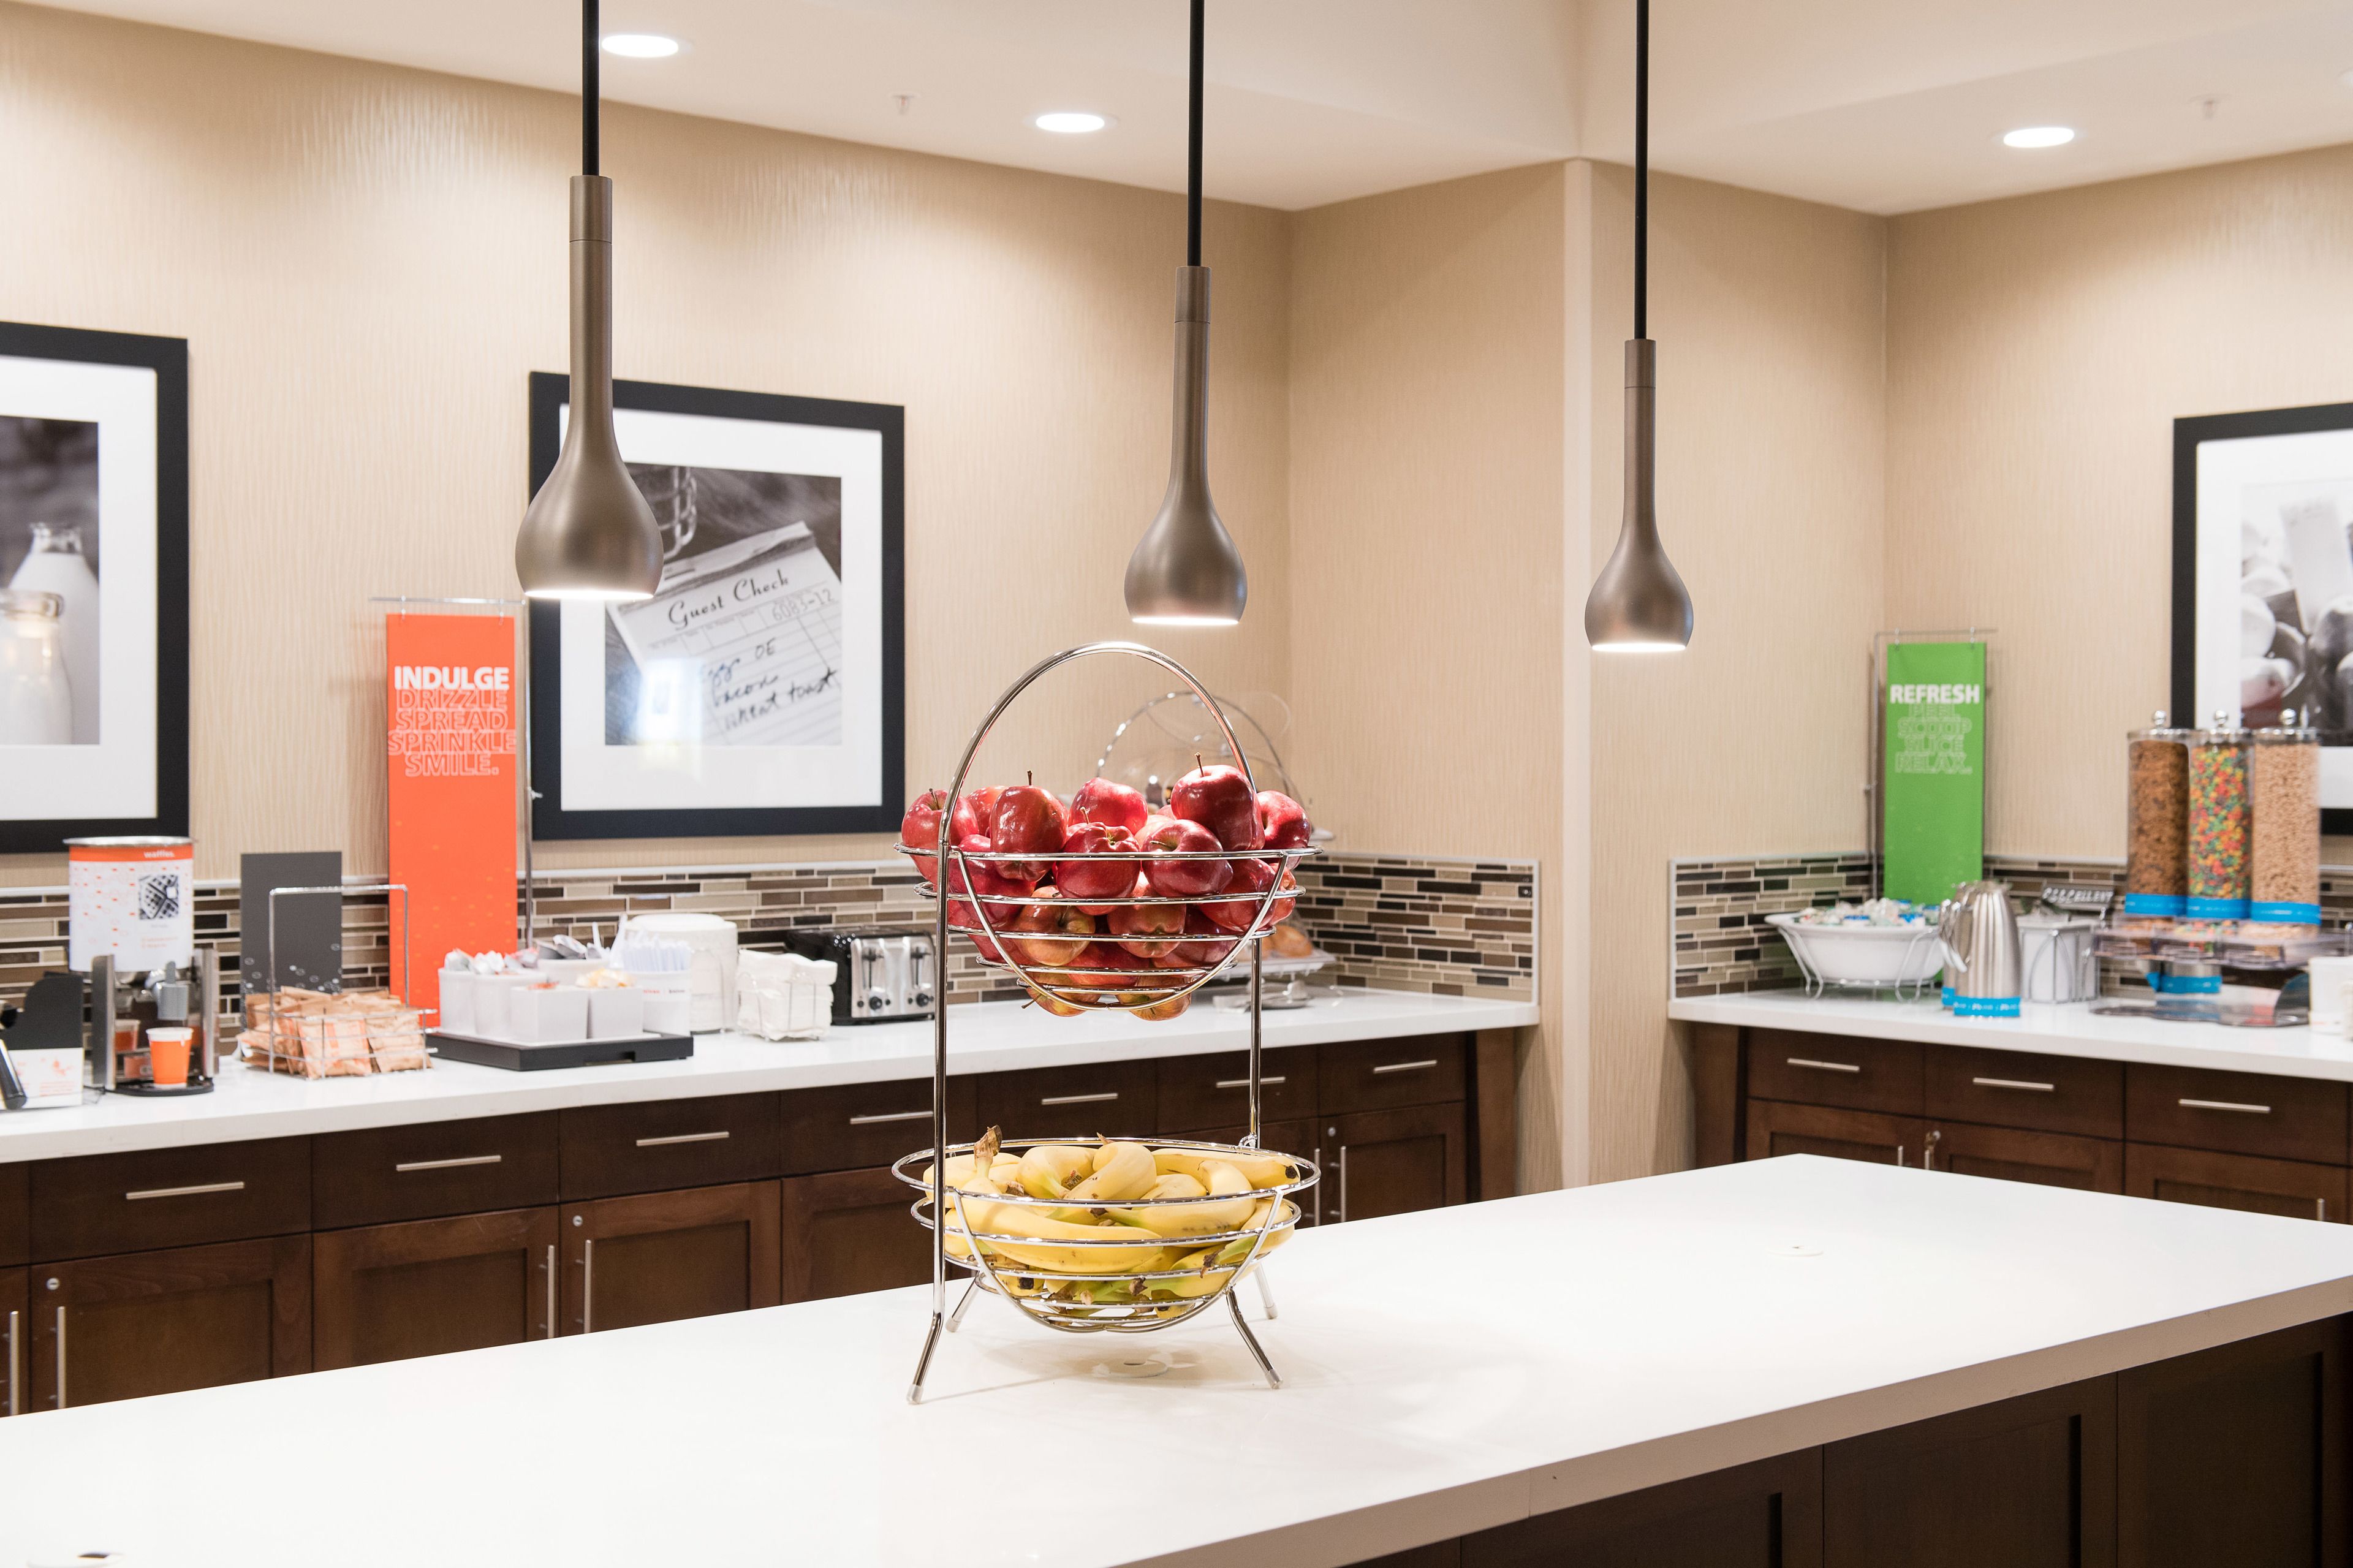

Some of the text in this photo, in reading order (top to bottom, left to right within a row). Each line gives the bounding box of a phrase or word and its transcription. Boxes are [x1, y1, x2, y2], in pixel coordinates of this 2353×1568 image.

[668, 569, 789, 631] Guest Check
[394, 665, 509, 691] INDULGE
[396, 687, 508, 711] DRIZZLE
[1890, 683, 1980, 704] REFRESH
[395, 707, 509, 733] SPREAD
[387, 729, 517, 756] SPRINKLE
[404, 751, 500, 778] SMILE.
